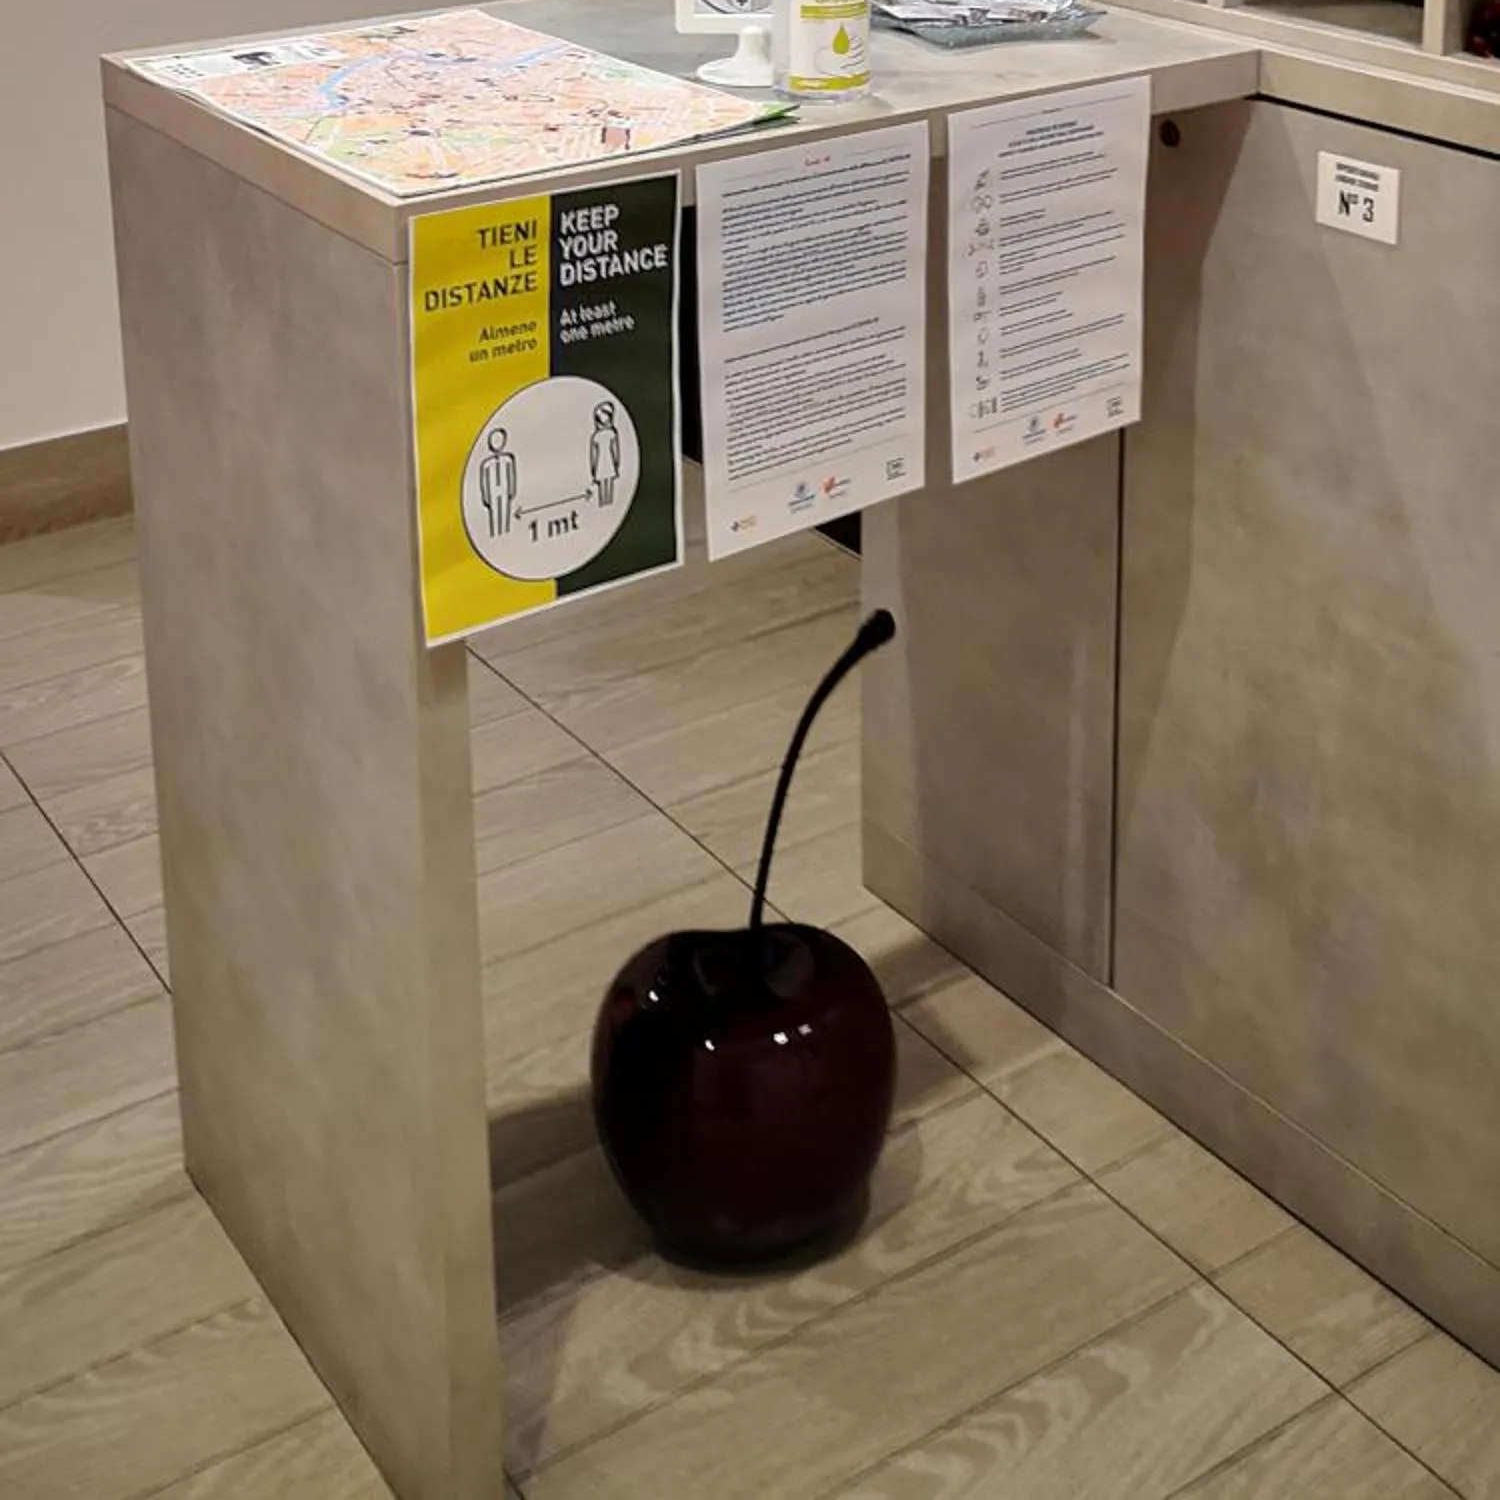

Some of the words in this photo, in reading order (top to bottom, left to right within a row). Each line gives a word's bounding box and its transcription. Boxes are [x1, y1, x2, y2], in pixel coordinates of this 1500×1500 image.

[477, 220, 537, 249] TIENI
[560, 204, 620, 236] KEEP
[509, 246, 537, 269] LE
[559, 230, 618, 260] YOUR
[559, 244, 668, 286] DISTANCE
[424, 273, 537, 312] DISTANZE
[560, 307, 577, 326] At
[579, 300, 617, 321] least
[479, 320, 537, 343] Almeno
[560, 325, 588, 344] one
[591, 315, 635, 337] metre
[469, 349, 489, 363] un
[492, 337, 537, 358] metro
[528, 521, 540, 542] 1
[547, 510, 581, 537] mt
